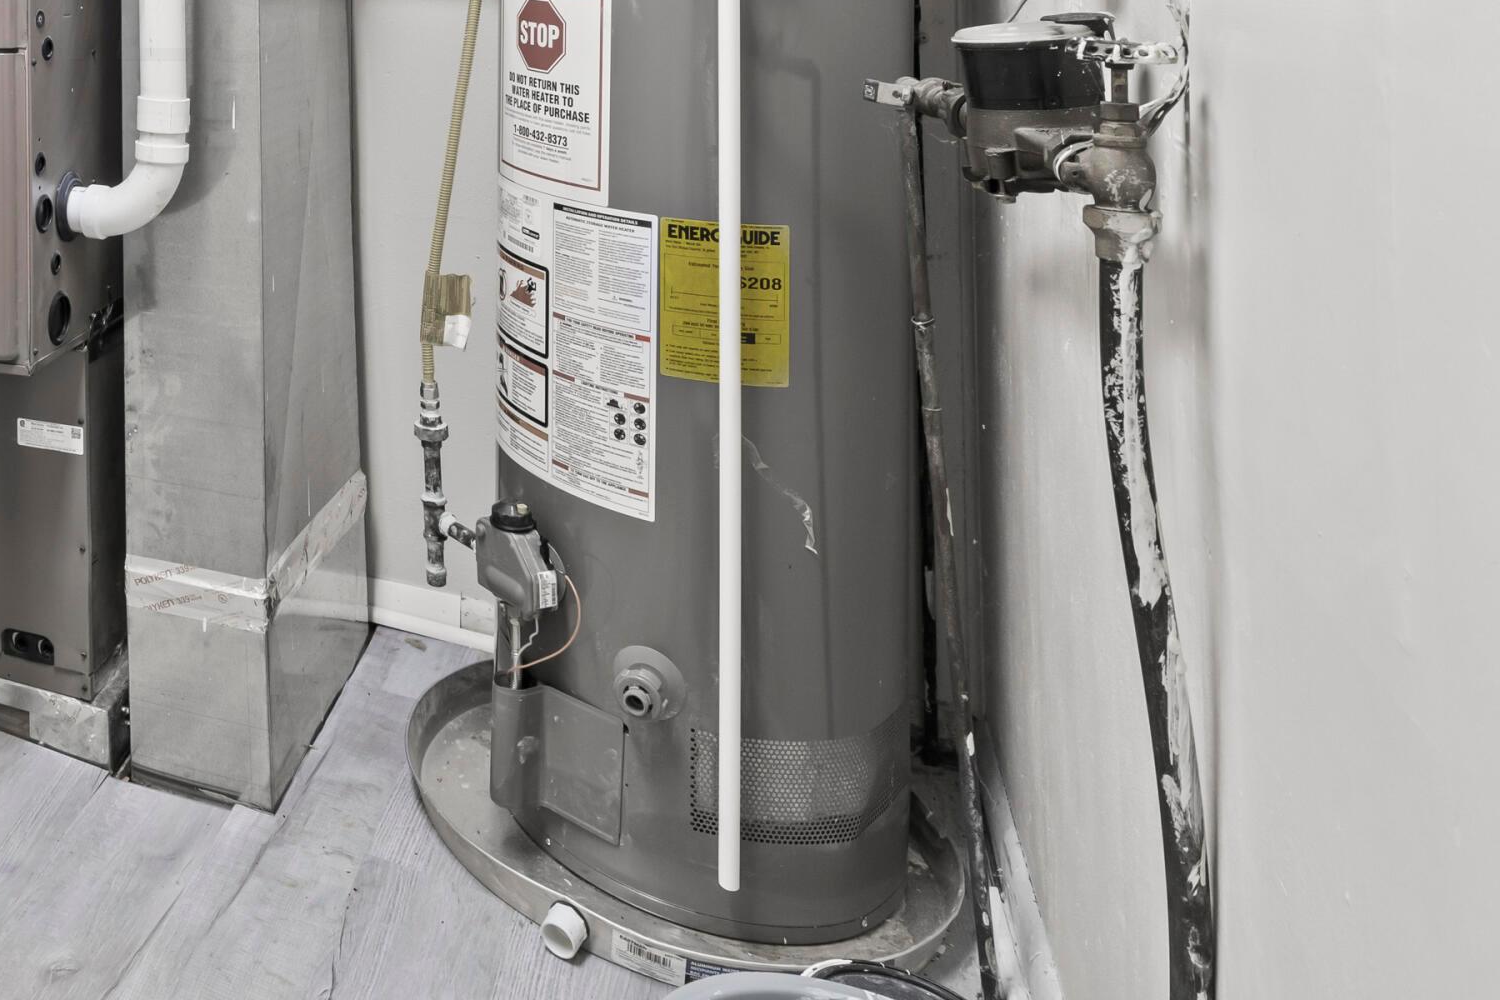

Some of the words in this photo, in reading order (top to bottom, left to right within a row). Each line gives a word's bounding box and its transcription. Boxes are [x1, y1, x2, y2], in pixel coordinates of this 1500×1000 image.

[520, 20, 560, 49] STOP
[509, 71, 516, 82] DO
[516, 73, 528, 85] NOT
[529, 76, 557, 92] RETURN
[560, 82, 580, 96] THIS
[511, 84, 530, 99] WATER
[531, 90, 560, 105] HEATER
[562, 96, 574, 108] TO
[505, 94, 513, 106] THE
[513, 97, 531, 112] PLACE
[533, 103, 542, 114] OF
[544, 105, 590, 124] PURCHASE
[513, 124, 568, 147] 1-800-432-8373
